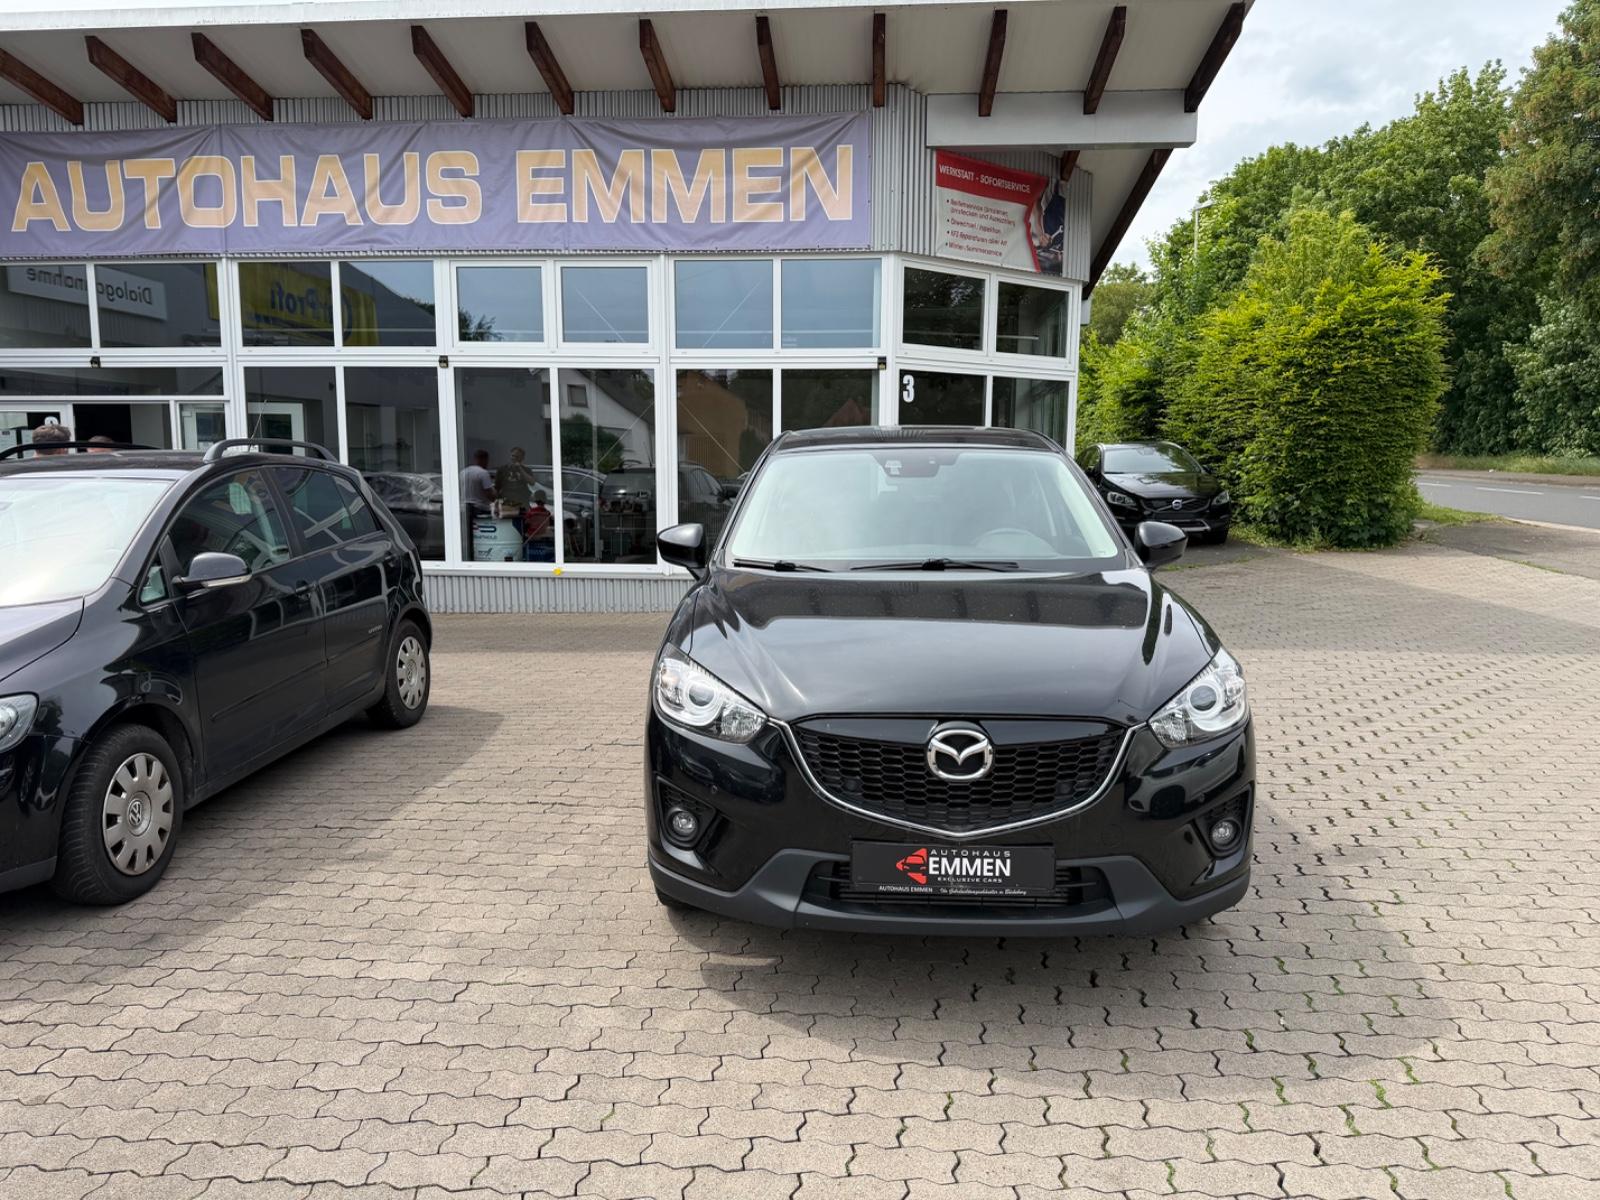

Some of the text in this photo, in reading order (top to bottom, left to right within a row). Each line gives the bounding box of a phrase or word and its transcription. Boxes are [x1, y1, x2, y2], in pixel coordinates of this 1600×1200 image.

[939, 163, 974, 181] WERKSTATT
[11, 144, 854, 233] AUTOHAUS EMMEN
[902, 374, 915, 403] 3
[930, 849, 1011, 858] AUTOHAUS
[928, 857, 1011, 877] EMMEN
[879, 885, 910, 893] AUTOHAUS
[910, 886, 933, 894] EMMEN
